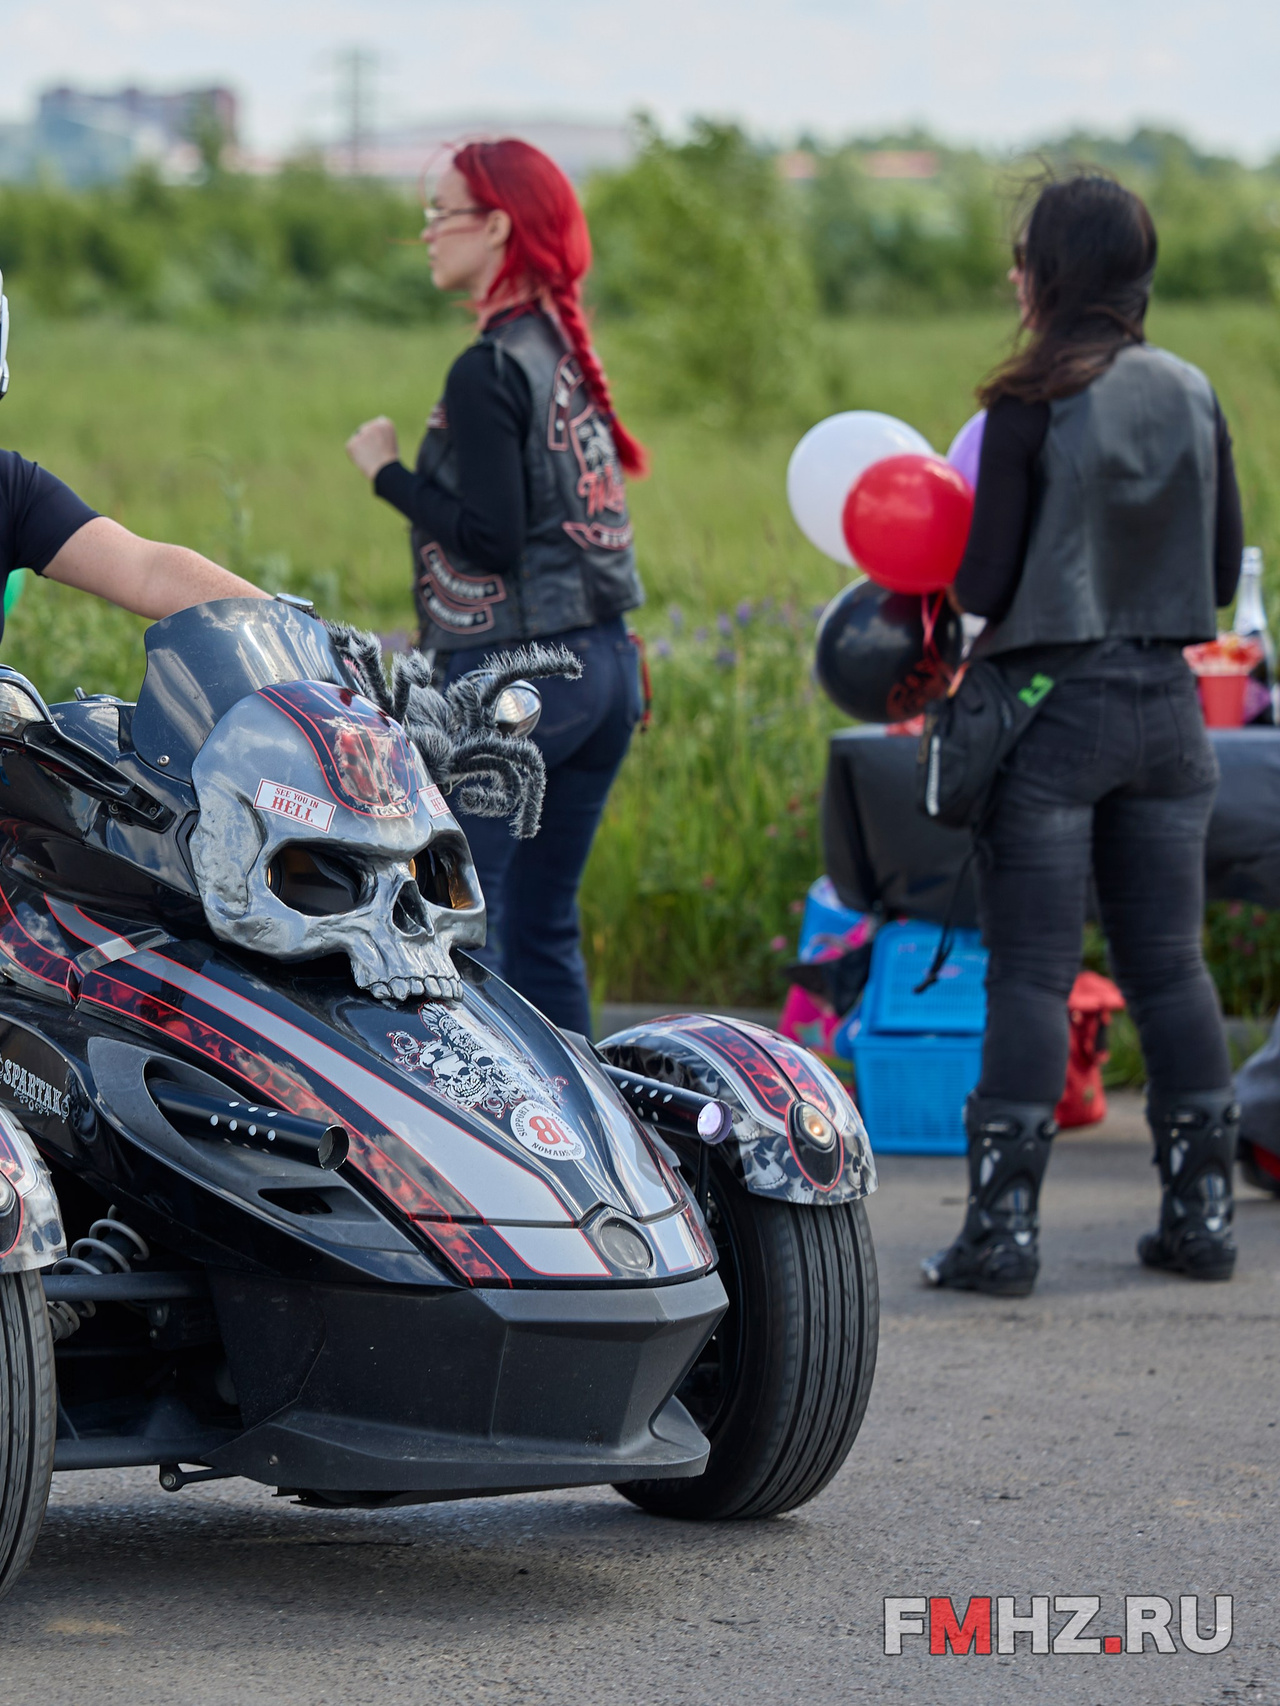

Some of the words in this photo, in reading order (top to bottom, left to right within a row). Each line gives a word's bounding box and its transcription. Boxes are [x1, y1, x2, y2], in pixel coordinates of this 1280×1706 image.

[271, 795, 314, 823] HELL
[275, 787, 291, 797] SEE
[293, 792, 309, 804] YOU
[309, 800, 319, 809] IN
[3, 1058, 62, 1116] SPARTAK
[514, 1105, 530, 1137] SUPPORT
[528, 1115, 574, 1146] 81
[531, 1142, 571, 1157] NOMADS
